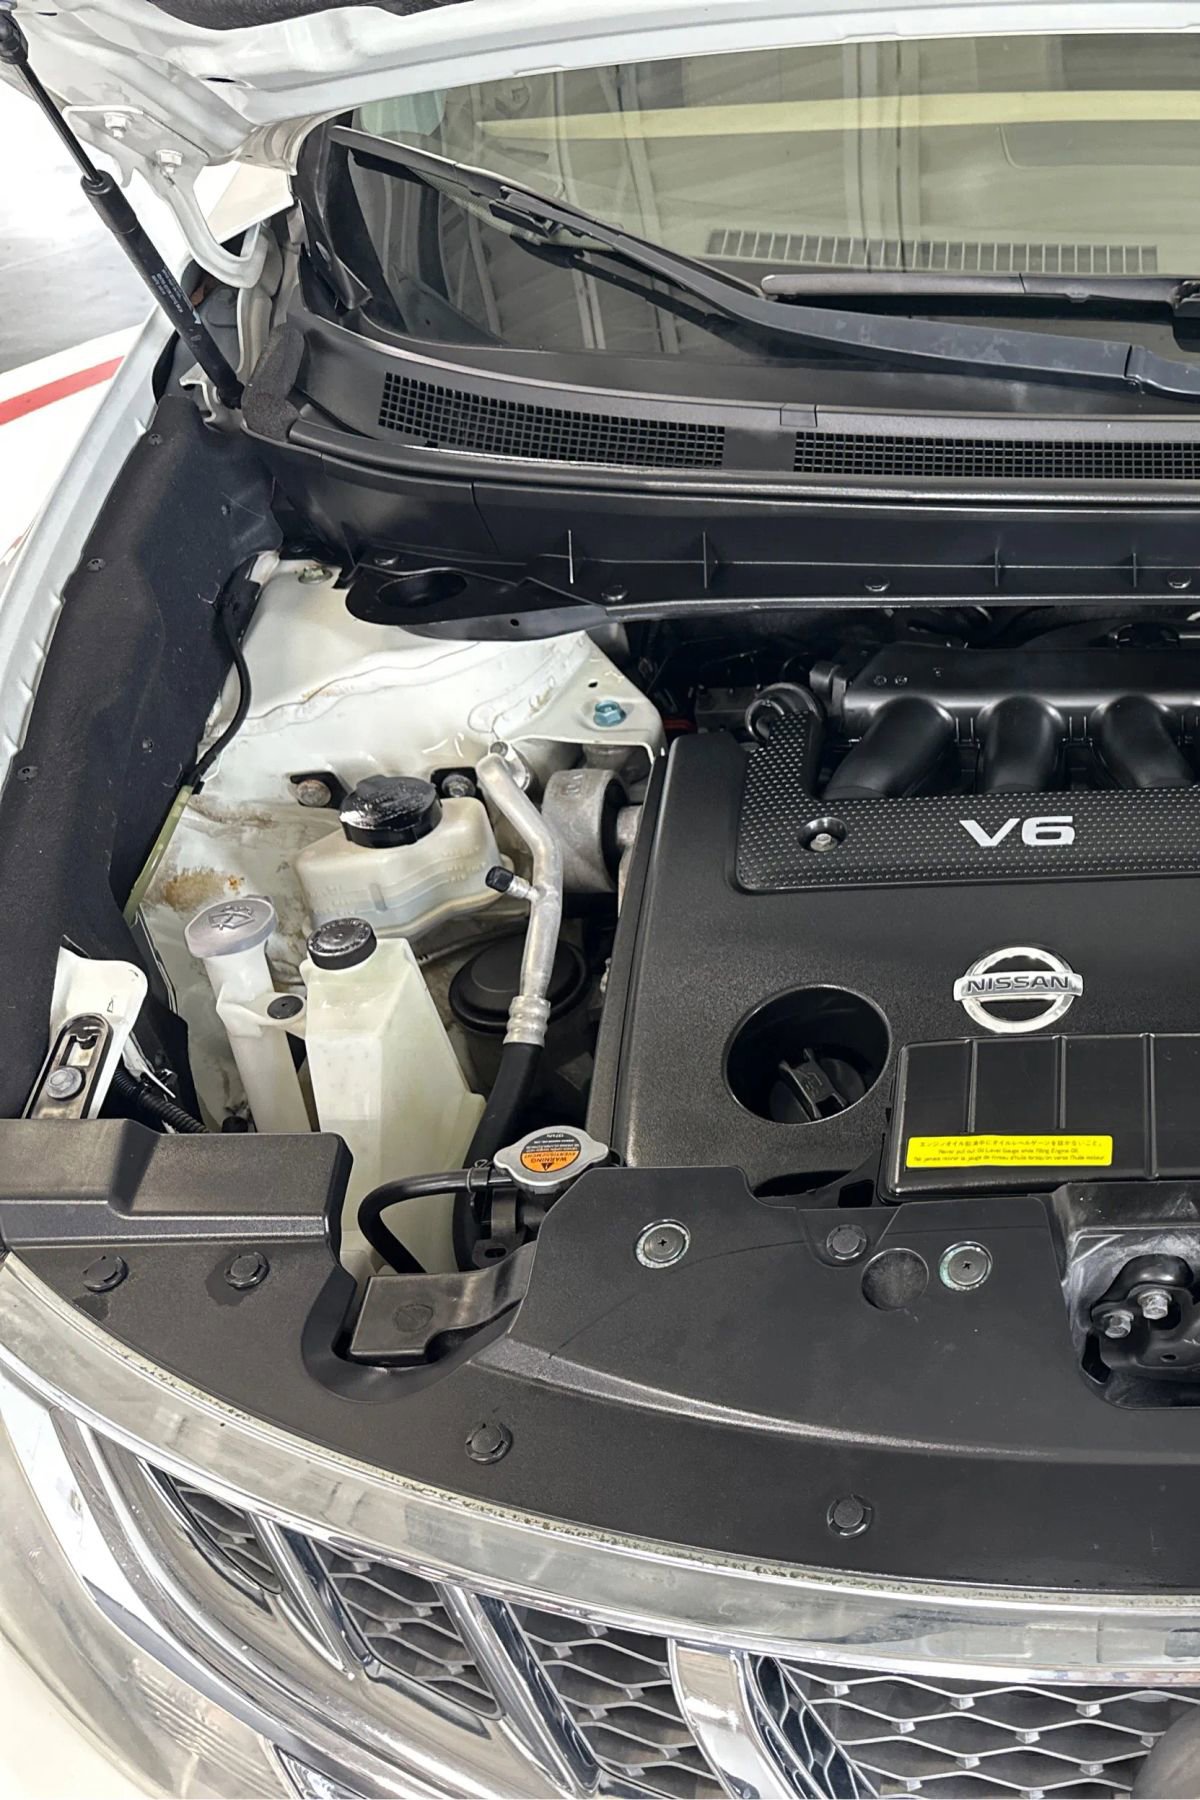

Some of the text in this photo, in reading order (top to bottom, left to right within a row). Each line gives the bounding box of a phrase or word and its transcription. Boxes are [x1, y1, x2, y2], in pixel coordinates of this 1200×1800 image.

[959, 815, 1075, 847] V6
[967, 975, 1069, 992] NISSAN
[530, 1156, 567, 1164] WARNING
